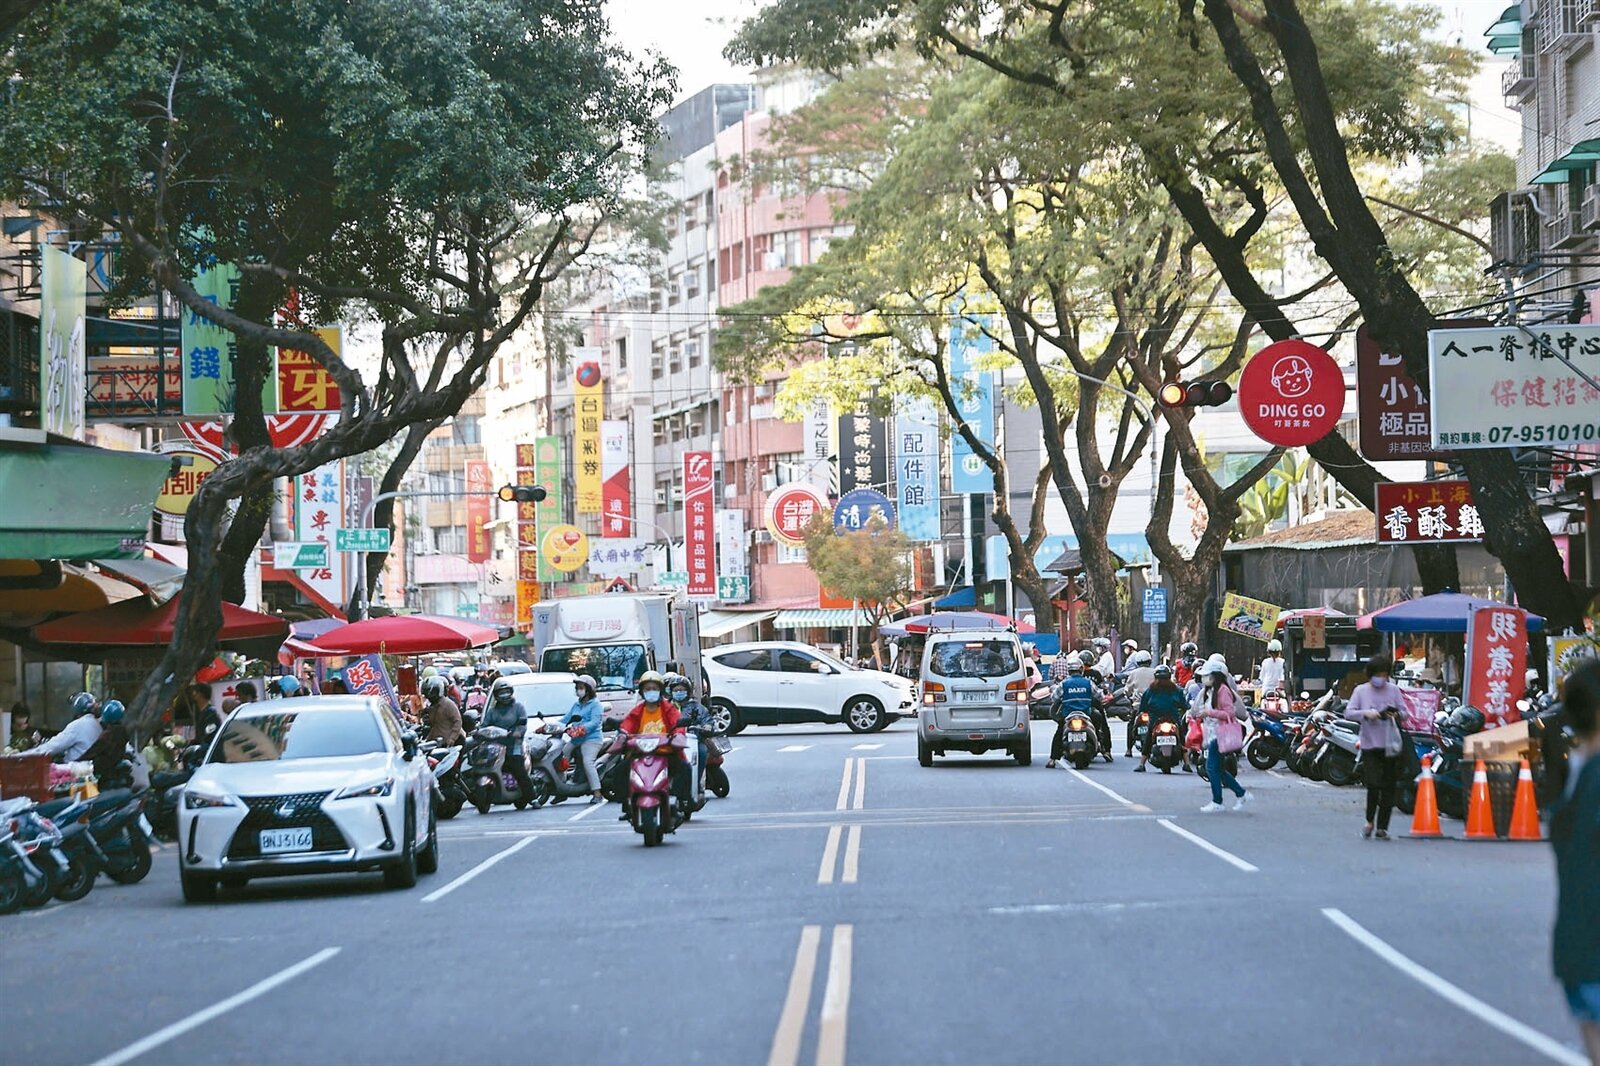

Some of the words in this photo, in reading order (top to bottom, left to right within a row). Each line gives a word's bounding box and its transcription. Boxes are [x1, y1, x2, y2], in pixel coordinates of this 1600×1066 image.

[1259, 404, 1298, 417] DING
[1302, 404, 1326, 417] GO
[1379, 412, 1431, 436] 極品
[1388, 441, 1440, 454] 非基因改
[903, 433, 924, 506] 配件館
[1402, 486, 1470, 504] 小上海
[1383, 504, 1486, 540] 香酥雞
[309, 510, 332, 580] 專店
[1145, 589, 1153, 600] P
